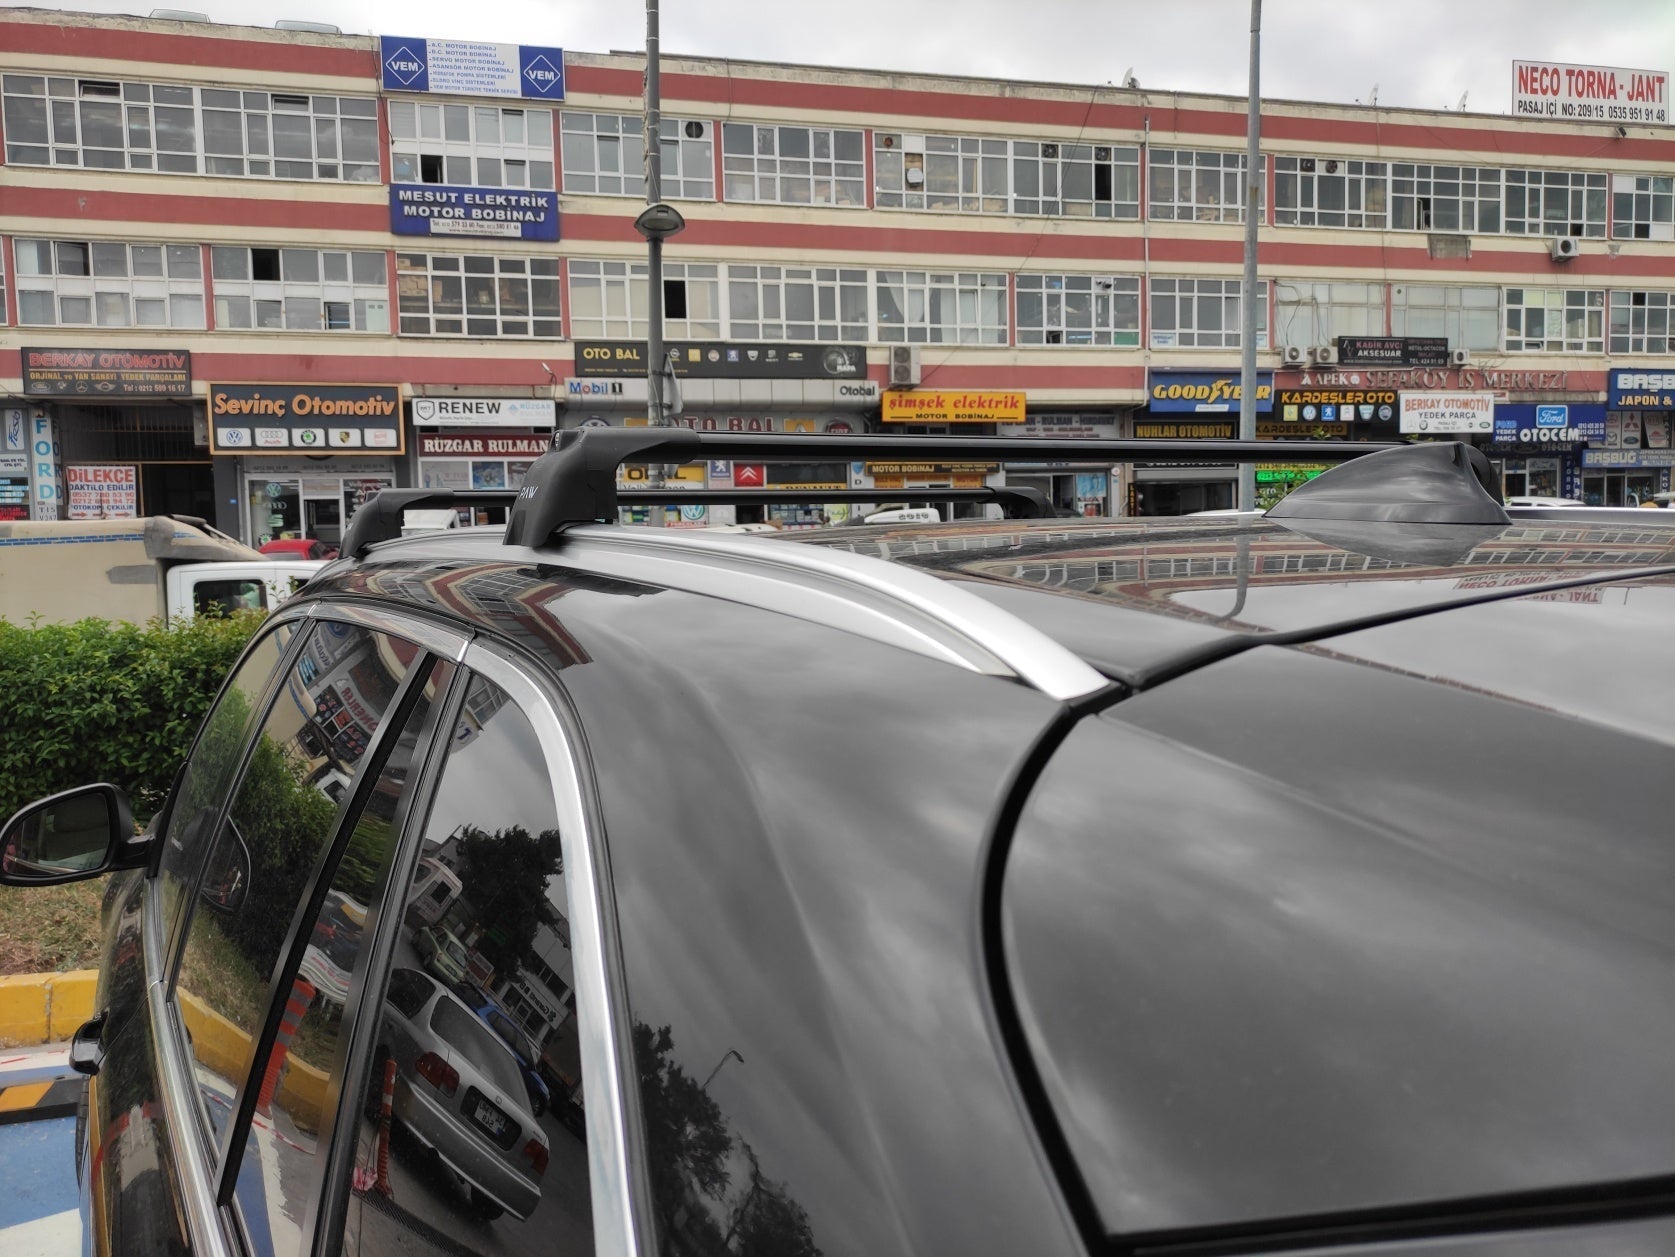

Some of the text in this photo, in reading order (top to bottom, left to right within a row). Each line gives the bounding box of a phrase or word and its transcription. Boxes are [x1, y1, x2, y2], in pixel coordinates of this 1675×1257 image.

[391, 61, 419, 72] VEM
[529, 70, 555, 81] VEM
[1518, 66, 1664, 103] NECO TORNA JANT
[1518, 98, 1665, 122] PASAJ İÇİ NO: 209/15 0535 951 91 48
[399, 190, 548, 208] MESUT ELEKTRİK
[404, 205, 545, 222] MOTOR BOBİNAJ
[29, 352, 185, 368] BERKAY OTOMOTİV
[583, 348, 640, 360] OTO BAL
[146, 374, 185, 382] PARÇALARI
[1366, 368, 1568, 390] SEFAKÖY İŞ MERKEZİ
[570, 382, 608, 393] Mobil
[840, 386, 874, 396] Otobal
[1153, 382, 1271, 402] GOODYER
[215, 394, 394, 417] Sevinç Otomotiv
[889, 395, 1019, 410] şimşek elektrik
[1282, 392, 1395, 405] KARDEŞLER OTO
[1405, 396, 1490, 412] BERKAY OTOMOTİV
[1618, 396, 1659, 406] JAPON
[438, 402, 501, 414] RENEW
[1449, 412, 1476, 420] PARÇA
[1539, 410, 1563, 422] Ford
[1136, 424, 1232, 437] NUHLAR OTOMOTİV
[1322, 425, 1344, 433] OTO
[1520, 428, 1579, 442] OTOCEM
[424, 437, 548, 452] RÜZGAR RULMAN
[35, 420, 55, 499] FORD
[1586, 450, 1636, 466] BAŞBUĞ
[68, 469, 133, 483] DİLEKÇE
